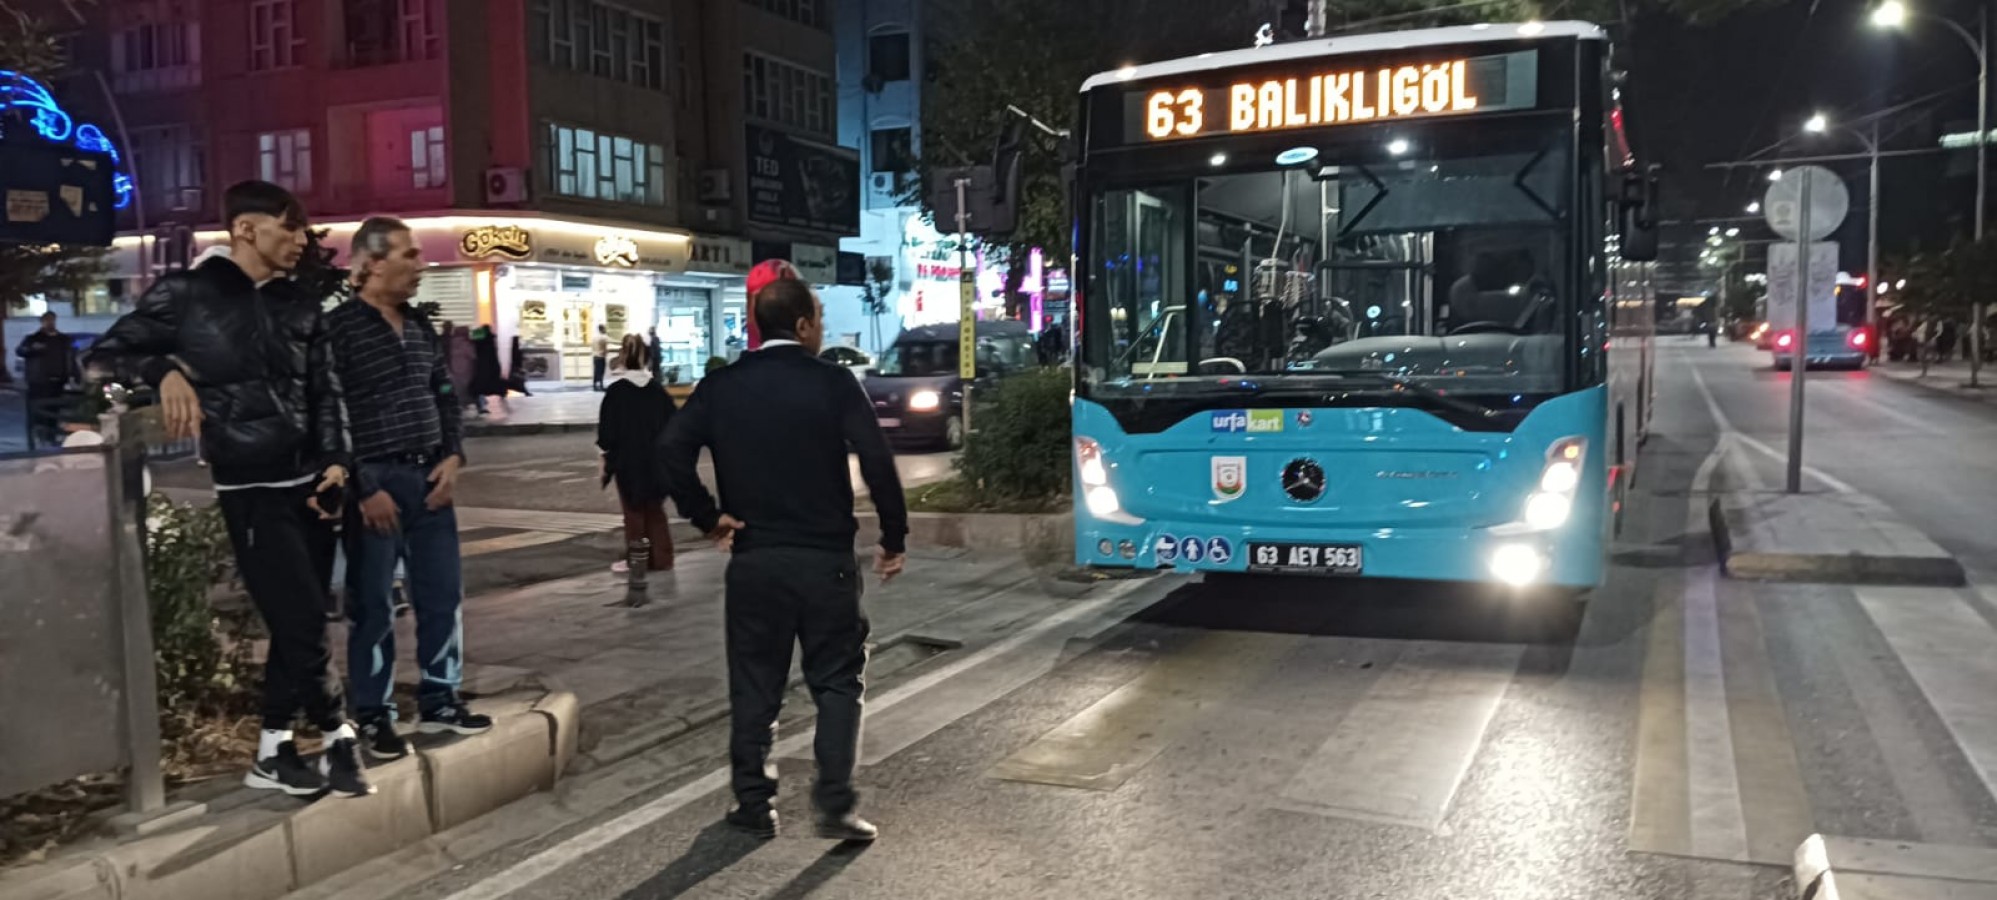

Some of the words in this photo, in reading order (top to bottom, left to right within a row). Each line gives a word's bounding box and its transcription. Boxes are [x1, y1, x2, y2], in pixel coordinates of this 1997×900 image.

[1147, 88, 1204, 138] 63
[1230, 60, 1478, 131] BALIKLIGÖL
[754, 155, 779, 177] TED
[1257, 546, 1278, 564] 63
[1288, 547, 1319, 566] AEY
[1324, 547, 1358, 567] 563
